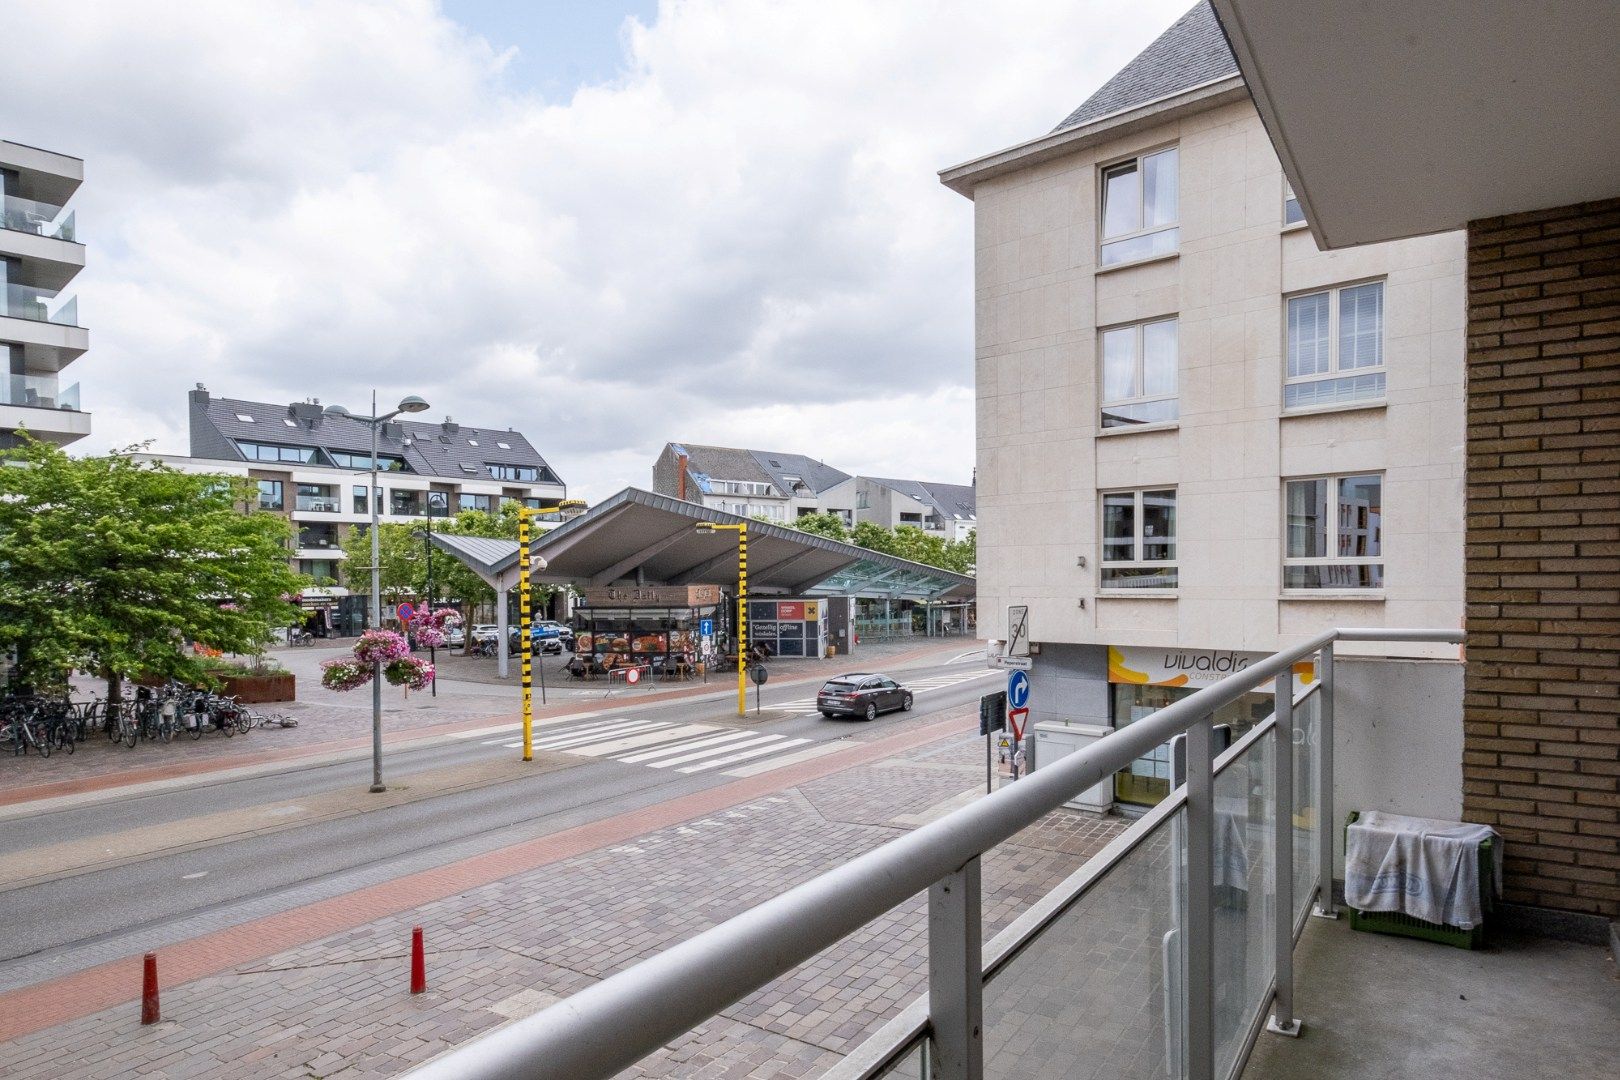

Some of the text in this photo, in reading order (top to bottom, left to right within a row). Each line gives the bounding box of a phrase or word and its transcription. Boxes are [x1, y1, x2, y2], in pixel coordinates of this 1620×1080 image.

[608, 589, 628, 602] The
[1012, 623, 1026, 638] 30
[1164, 650, 1249, 672] vivaldis
[1189, 672, 1231, 681] CONSTR
